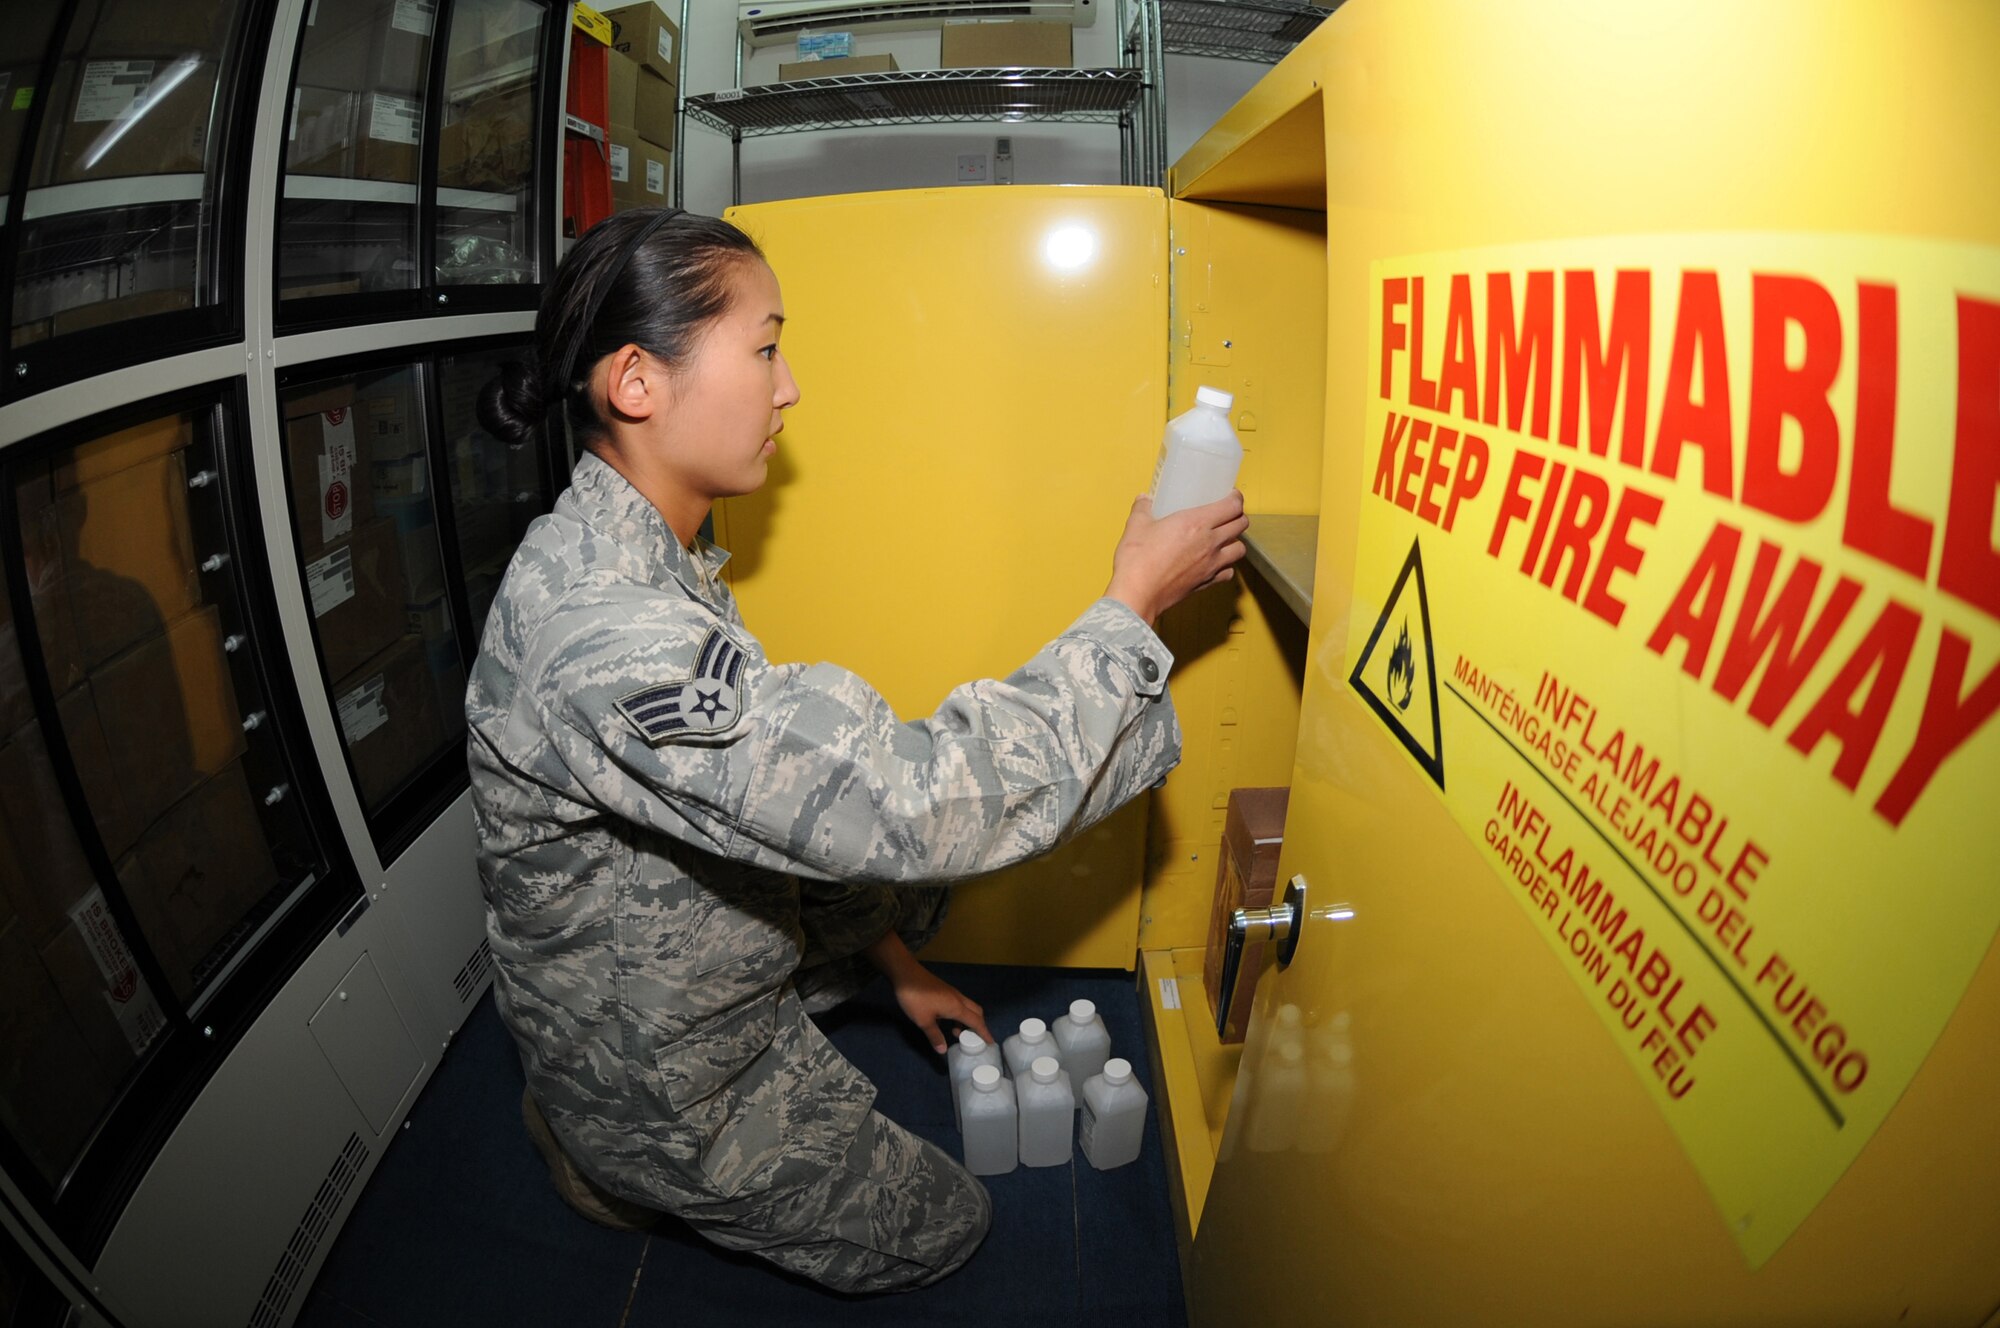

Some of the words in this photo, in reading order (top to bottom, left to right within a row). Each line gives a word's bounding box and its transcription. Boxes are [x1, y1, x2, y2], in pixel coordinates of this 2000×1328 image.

[716, 91, 741, 101] A0001
[332, 486, 342, 515] STOP
[1373, 412, 1490, 533] KEEP
[1487, 449, 1666, 628] FIRE
[1647, 519, 2000, 829] AWAY
[1453, 654, 1582, 783] MANTÉNGASE
[1578, 772, 1699, 898] ALEJADO
[1696, 886, 1754, 967] DEL
[1755, 953, 1869, 1095] FUEGO
[1496, 781, 1718, 1058] INFLAMMABLE
[1533, 671, 1770, 900] INFLAMABLE
[1483, 819, 1561, 921] GARDER
[1557, 911, 1611, 986] LOIN
[1606, 978, 1646, 1031] DU
[1640, 1026, 1695, 1100] FEU
